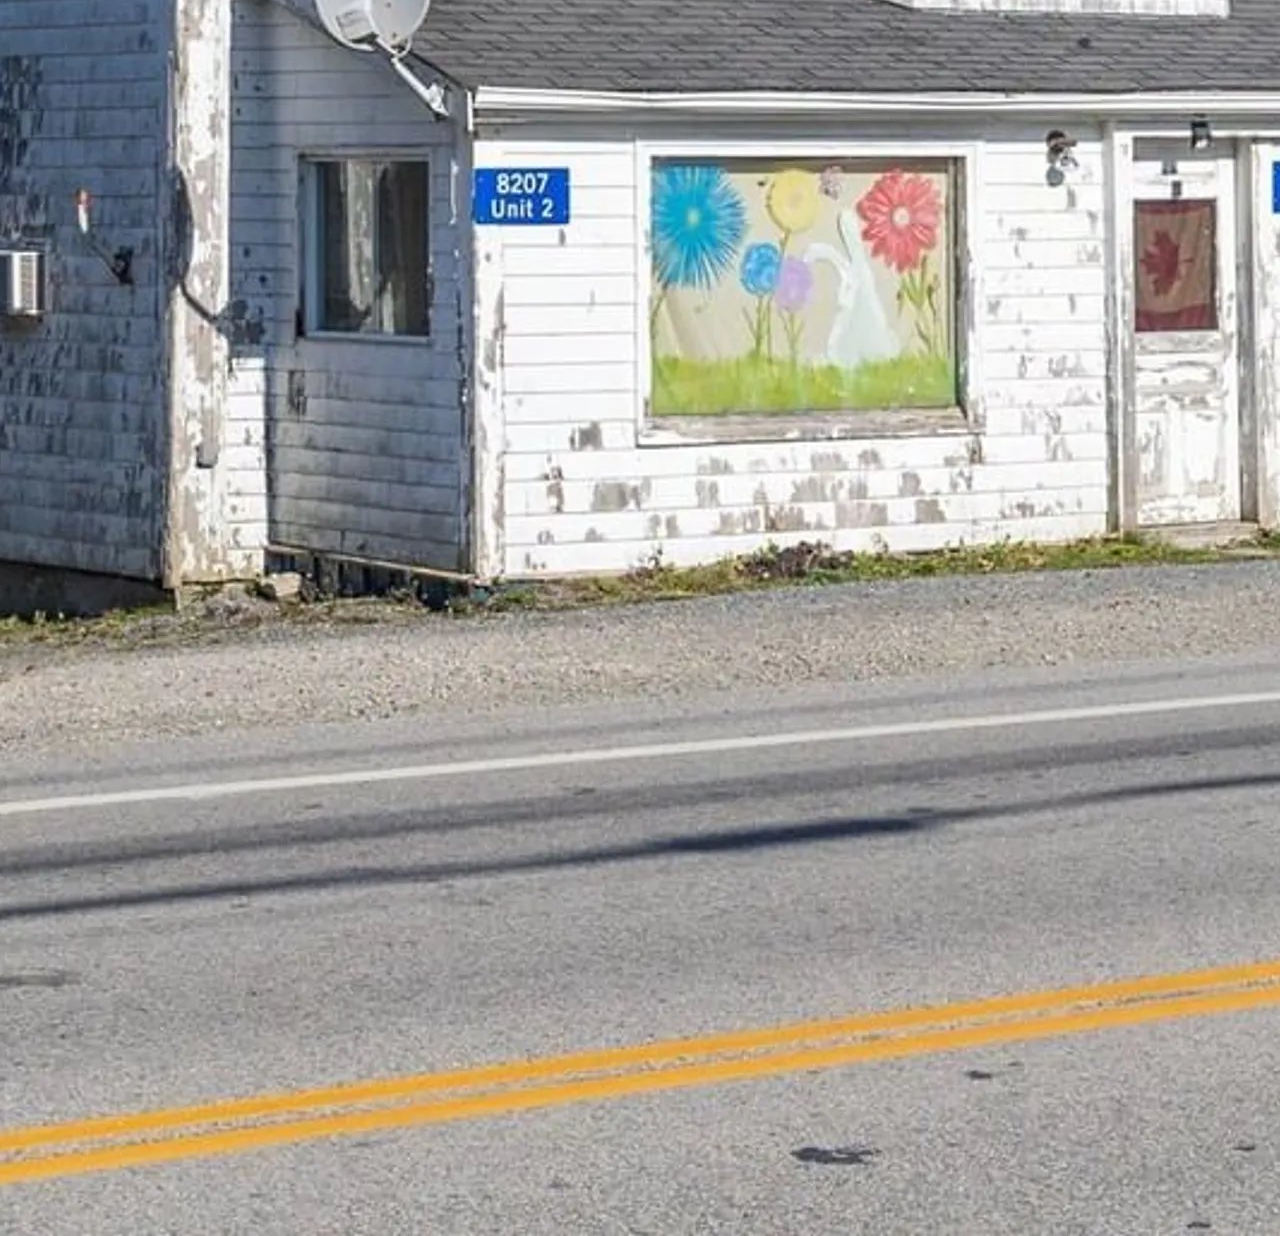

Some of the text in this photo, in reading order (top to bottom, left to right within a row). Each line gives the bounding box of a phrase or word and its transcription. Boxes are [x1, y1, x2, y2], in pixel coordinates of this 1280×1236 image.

[496, 172, 548, 194] 8207
[490, 198, 553, 218] Unit 2
